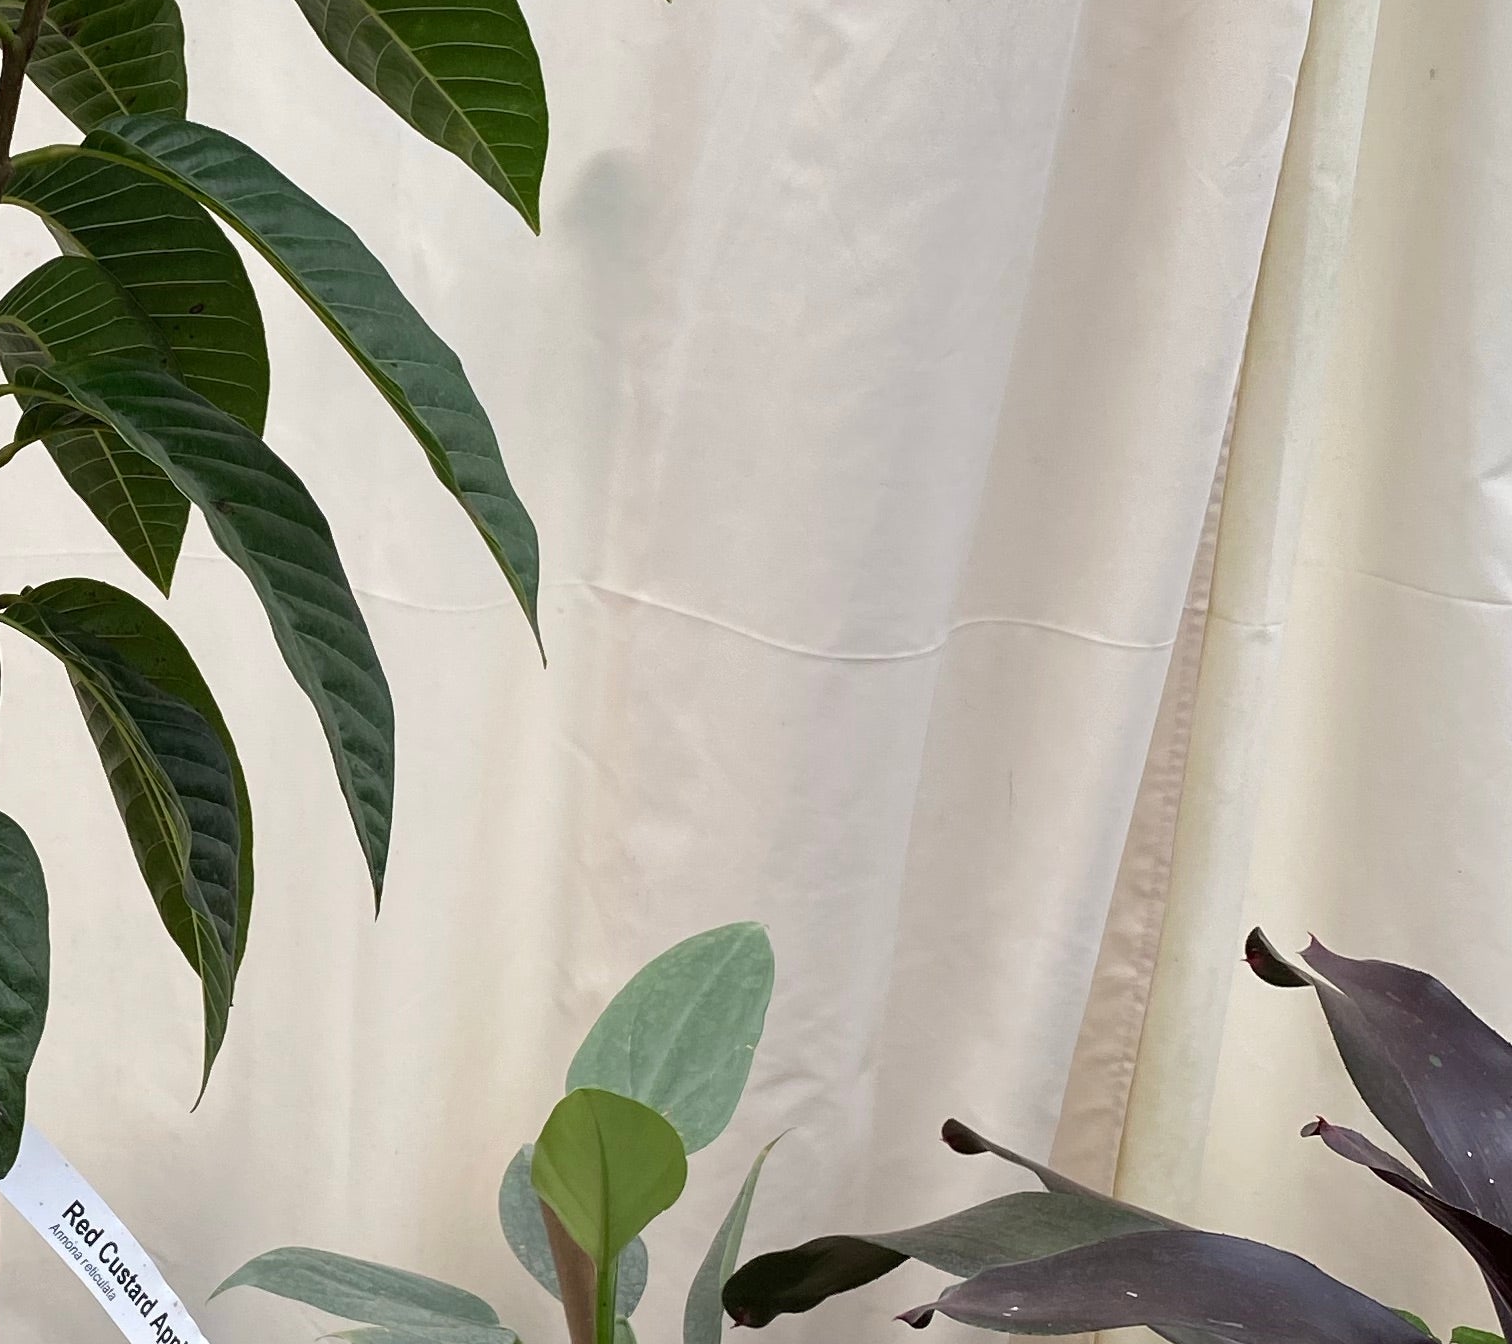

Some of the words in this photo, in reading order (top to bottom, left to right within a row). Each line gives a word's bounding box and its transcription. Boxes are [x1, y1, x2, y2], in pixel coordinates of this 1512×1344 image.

[48, 1222, 82, 1260] Annona
[79, 1257, 116, 1302] reticulata
[61, 1199, 104, 1247] Red
[98, 1243, 158, 1318] Custard
